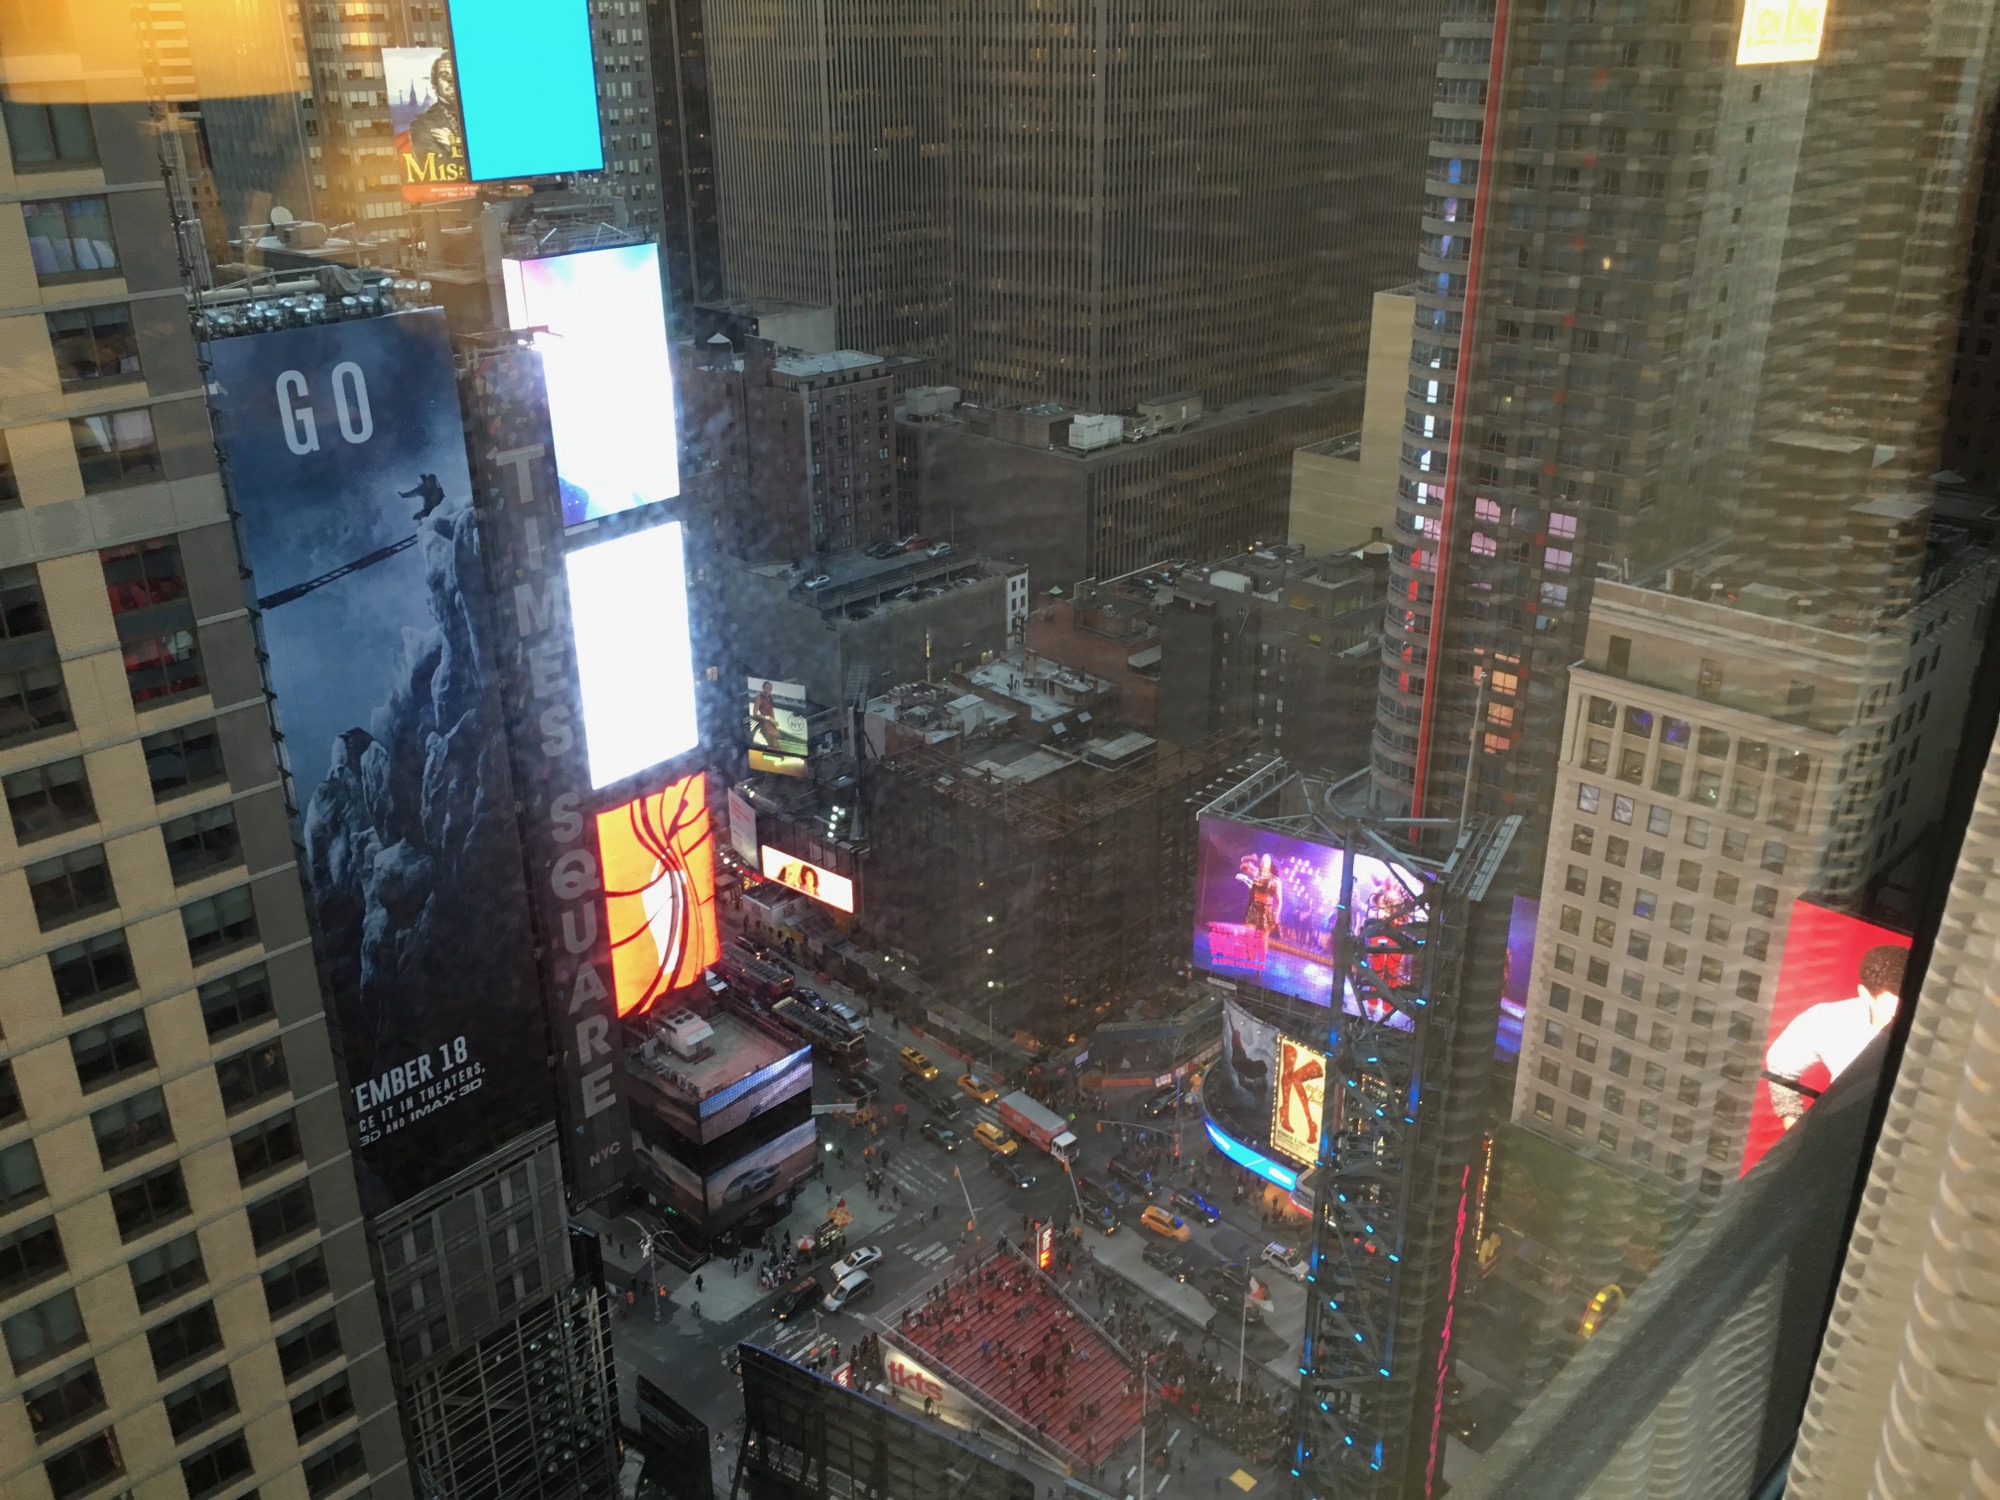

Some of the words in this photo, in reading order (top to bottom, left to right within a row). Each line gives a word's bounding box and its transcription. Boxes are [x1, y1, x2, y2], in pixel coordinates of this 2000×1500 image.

[276, 361, 373, 455] GO
[496, 444, 574, 757] TIMES
[551, 792, 617, 1118] SQUARE
[351, 1053, 434, 1113] EMBER
[438, 1035, 468, 1073] 18
[381, 1105, 394, 1122] IT
[400, 1095, 414, 1113] IN
[419, 1061, 486, 1103] THEATERS,
[359, 1129, 382, 1148] 3D
[386, 1117, 406, 1135] AND
[459, 1077, 483, 1097] 3D
[589, 1141, 621, 1168] NYC
[887, 1360, 944, 1402] tkts
